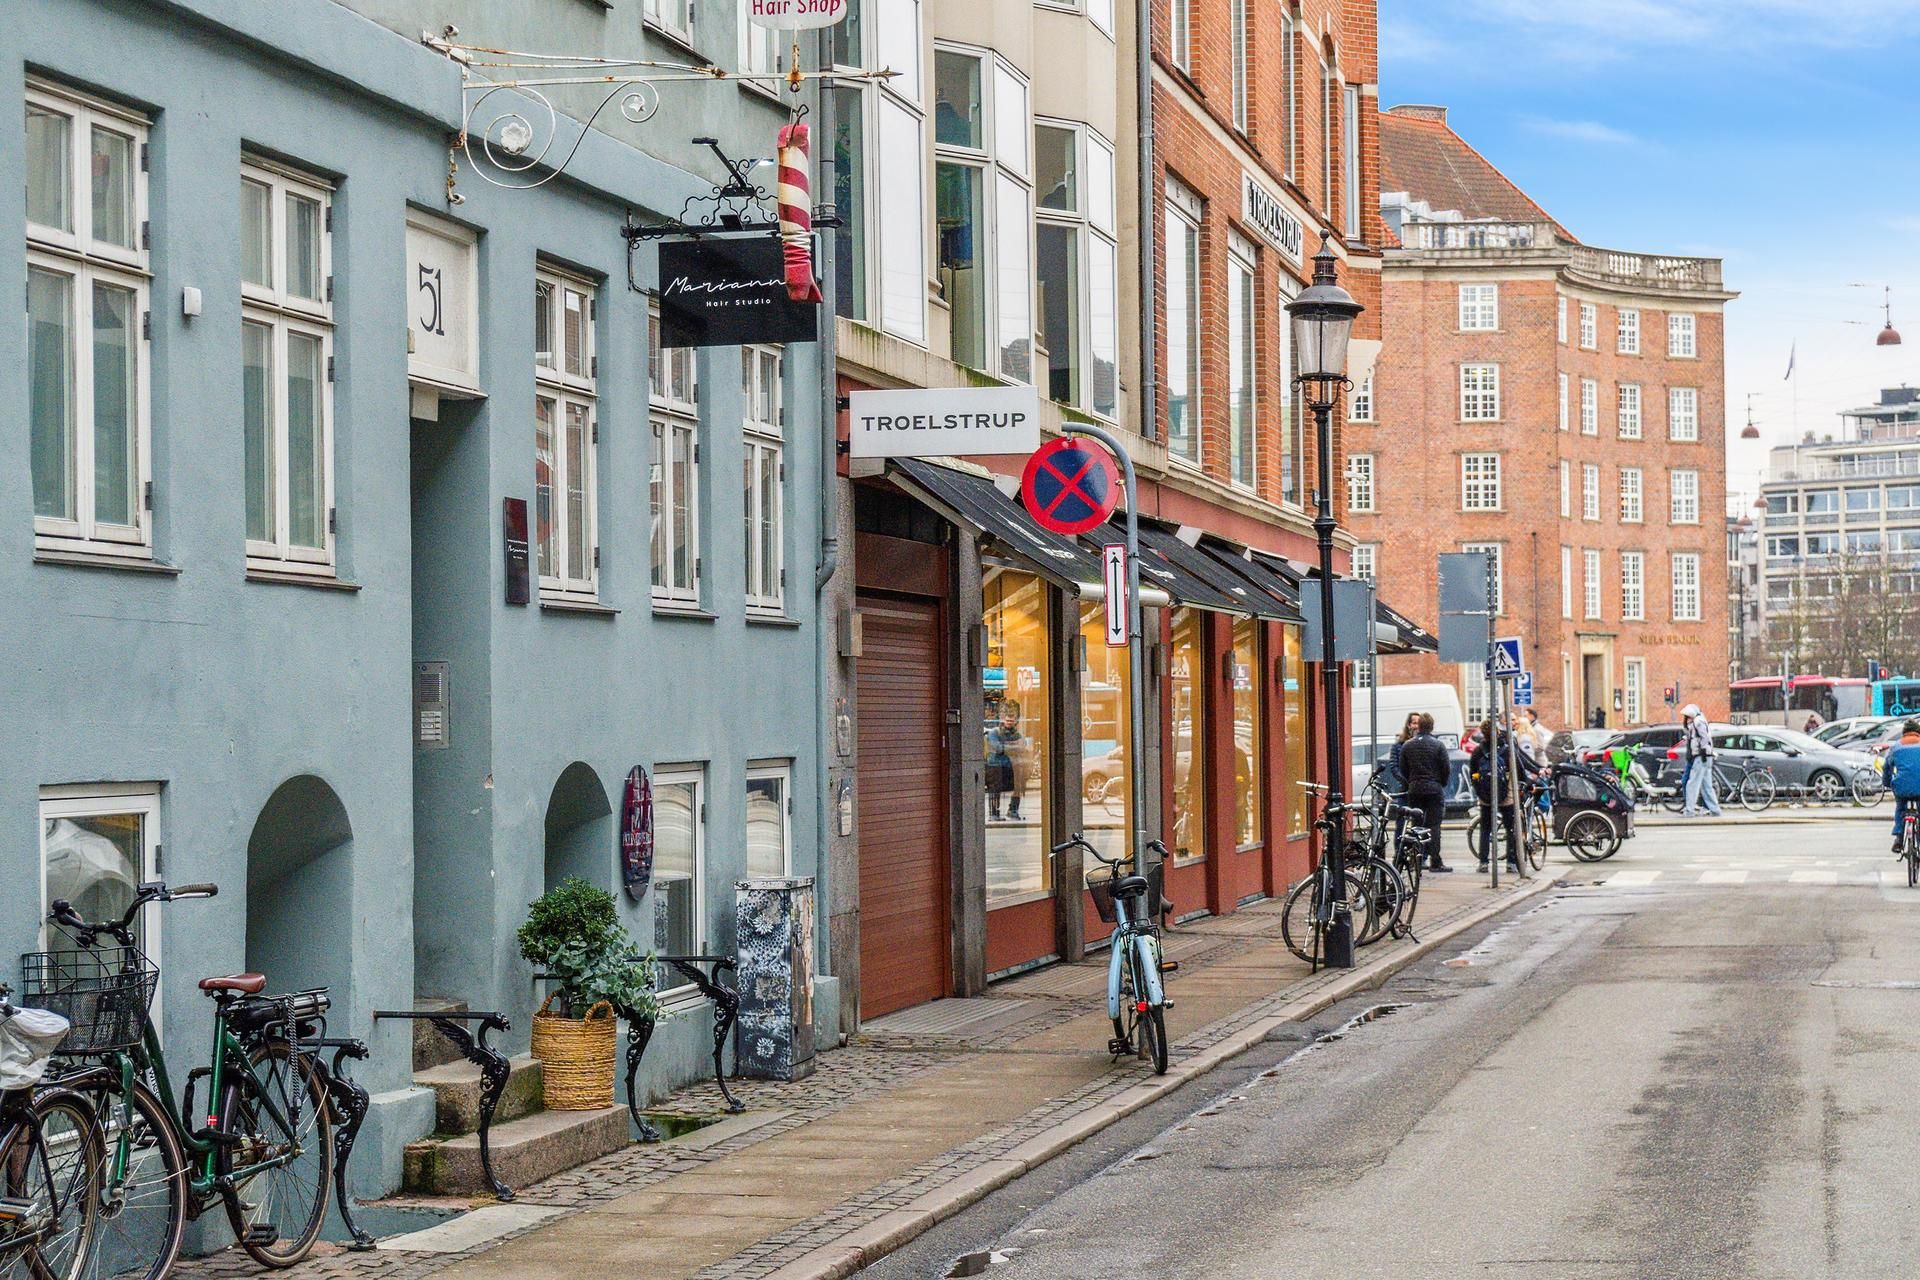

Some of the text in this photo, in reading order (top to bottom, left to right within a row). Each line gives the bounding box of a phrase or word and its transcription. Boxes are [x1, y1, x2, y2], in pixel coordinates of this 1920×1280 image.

[752, 0, 841, 16] Hair Shop
[1250, 182, 1303, 257] TROELSTRUP
[664, 276, 786, 297] Mariann
[419, 262, 445, 336] 51
[735, 298, 771, 306] Studio
[861, 413, 1026, 431] TROELSTRUP
[1517, 673, 1530, 689] P
